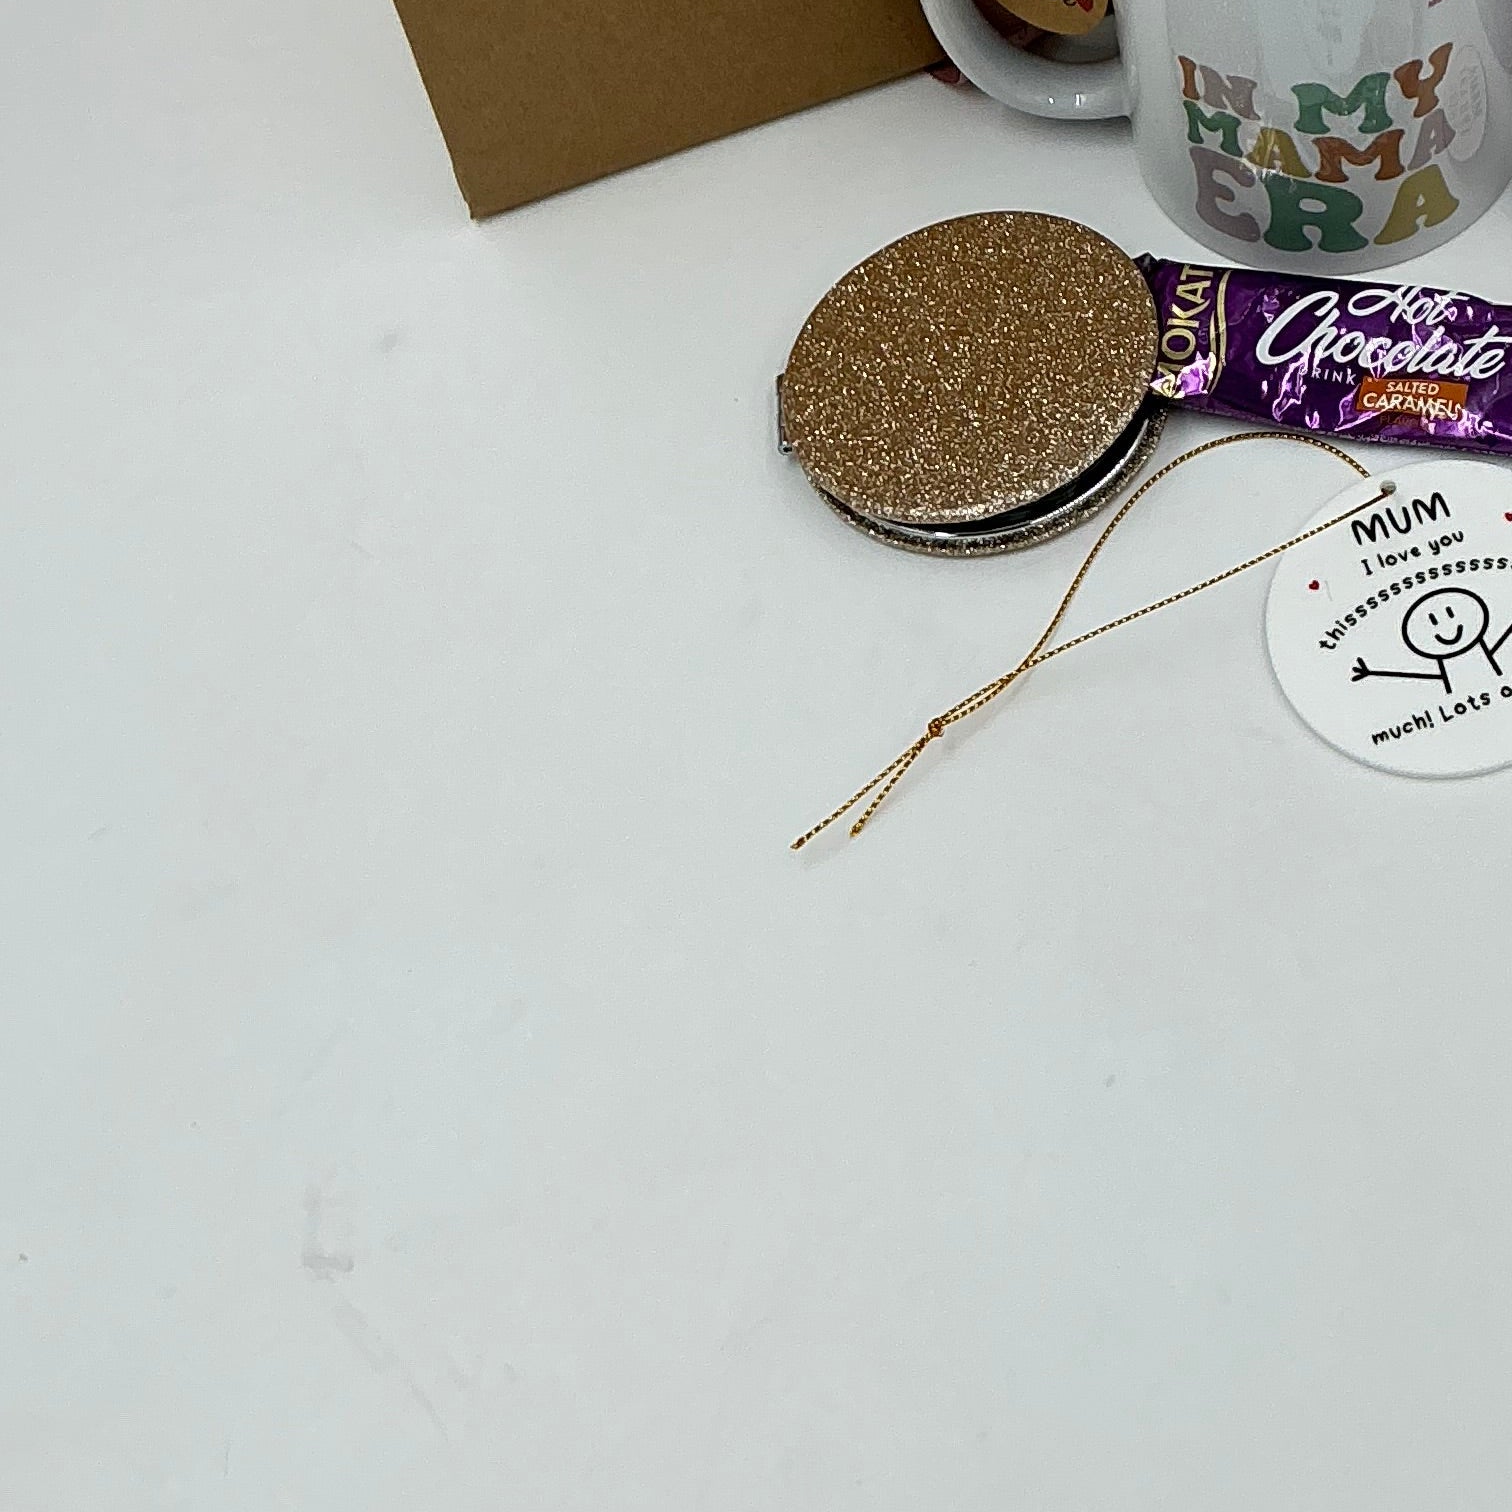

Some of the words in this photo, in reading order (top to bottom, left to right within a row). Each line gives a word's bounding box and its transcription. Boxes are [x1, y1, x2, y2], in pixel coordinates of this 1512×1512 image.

[1178, 55, 1261, 120] IN
[1291, 41, 1454, 135] MY
[1182, 100, 1456, 184] MAMA
[1189, 145, 1461, 253] ERA
[1348, 285, 1470, 326] Hot
[1363, 392, 1461, 420] CARAMEL
[1386, 381, 1439, 396] SALTED
[1351, 491, 1451, 545] MUM
[1361, 559, 1373, 576] I
[1377, 546, 1421, 568] love
[1428, 530, 1465, 555] you
[1370, 710, 1436, 746] much!
[1438, 690, 1491, 723] Lots
